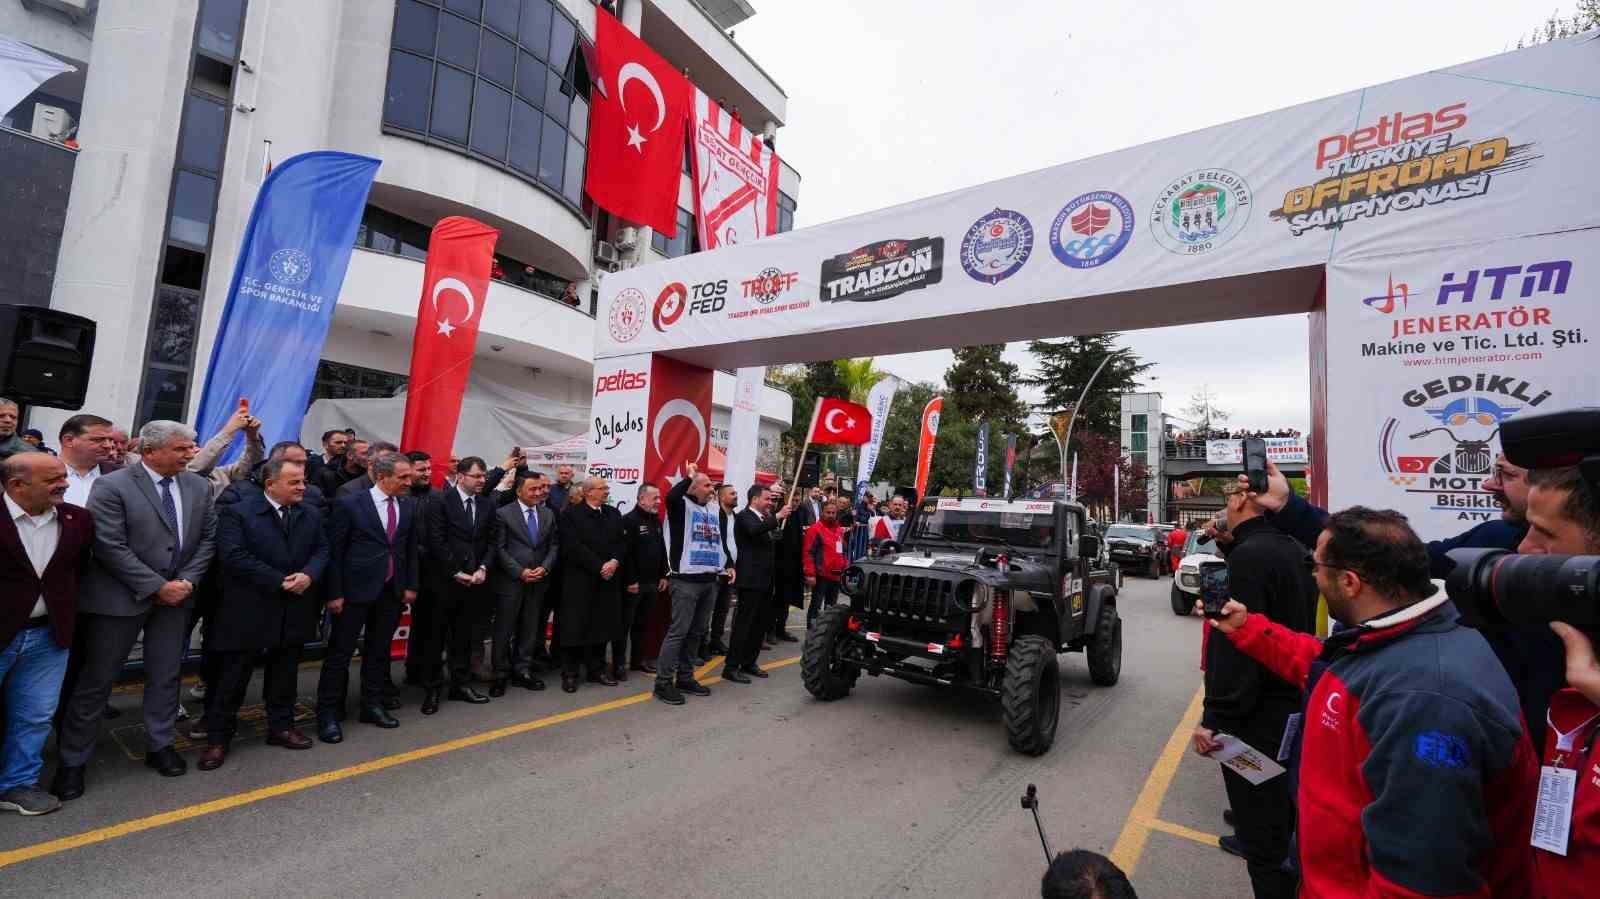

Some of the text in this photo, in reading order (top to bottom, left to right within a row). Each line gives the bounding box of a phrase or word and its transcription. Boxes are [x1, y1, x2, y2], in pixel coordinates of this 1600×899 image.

[1315, 102, 1467, 170] petlas
[1329, 133, 1453, 177] TÜRKİYE
[1283, 136, 1509, 214] OFFROAD
[692, 279, 728, 299] TOS
[827, 251, 933, 299] TRABZON
[1436, 260, 1573, 306] HTM
[240, 286, 267, 300] SPOR
[311, 295, 323, 304] VE
[689, 297, 726, 316] FED
[1392, 305, 1552, 339] JENERATÖR
[1362, 328, 1588, 357] Makine ve Tic. Ltd. Şti.
[1403, 351, 1543, 367] www.htmjenerator.com
[595, 369, 647, 397] petlas
[595, 411, 643, 445] Salados
[1429, 477, 1482, 490] MOT
[1437, 494, 1503, 508] Bisikle
[1457, 511, 1491, 522] ATV
